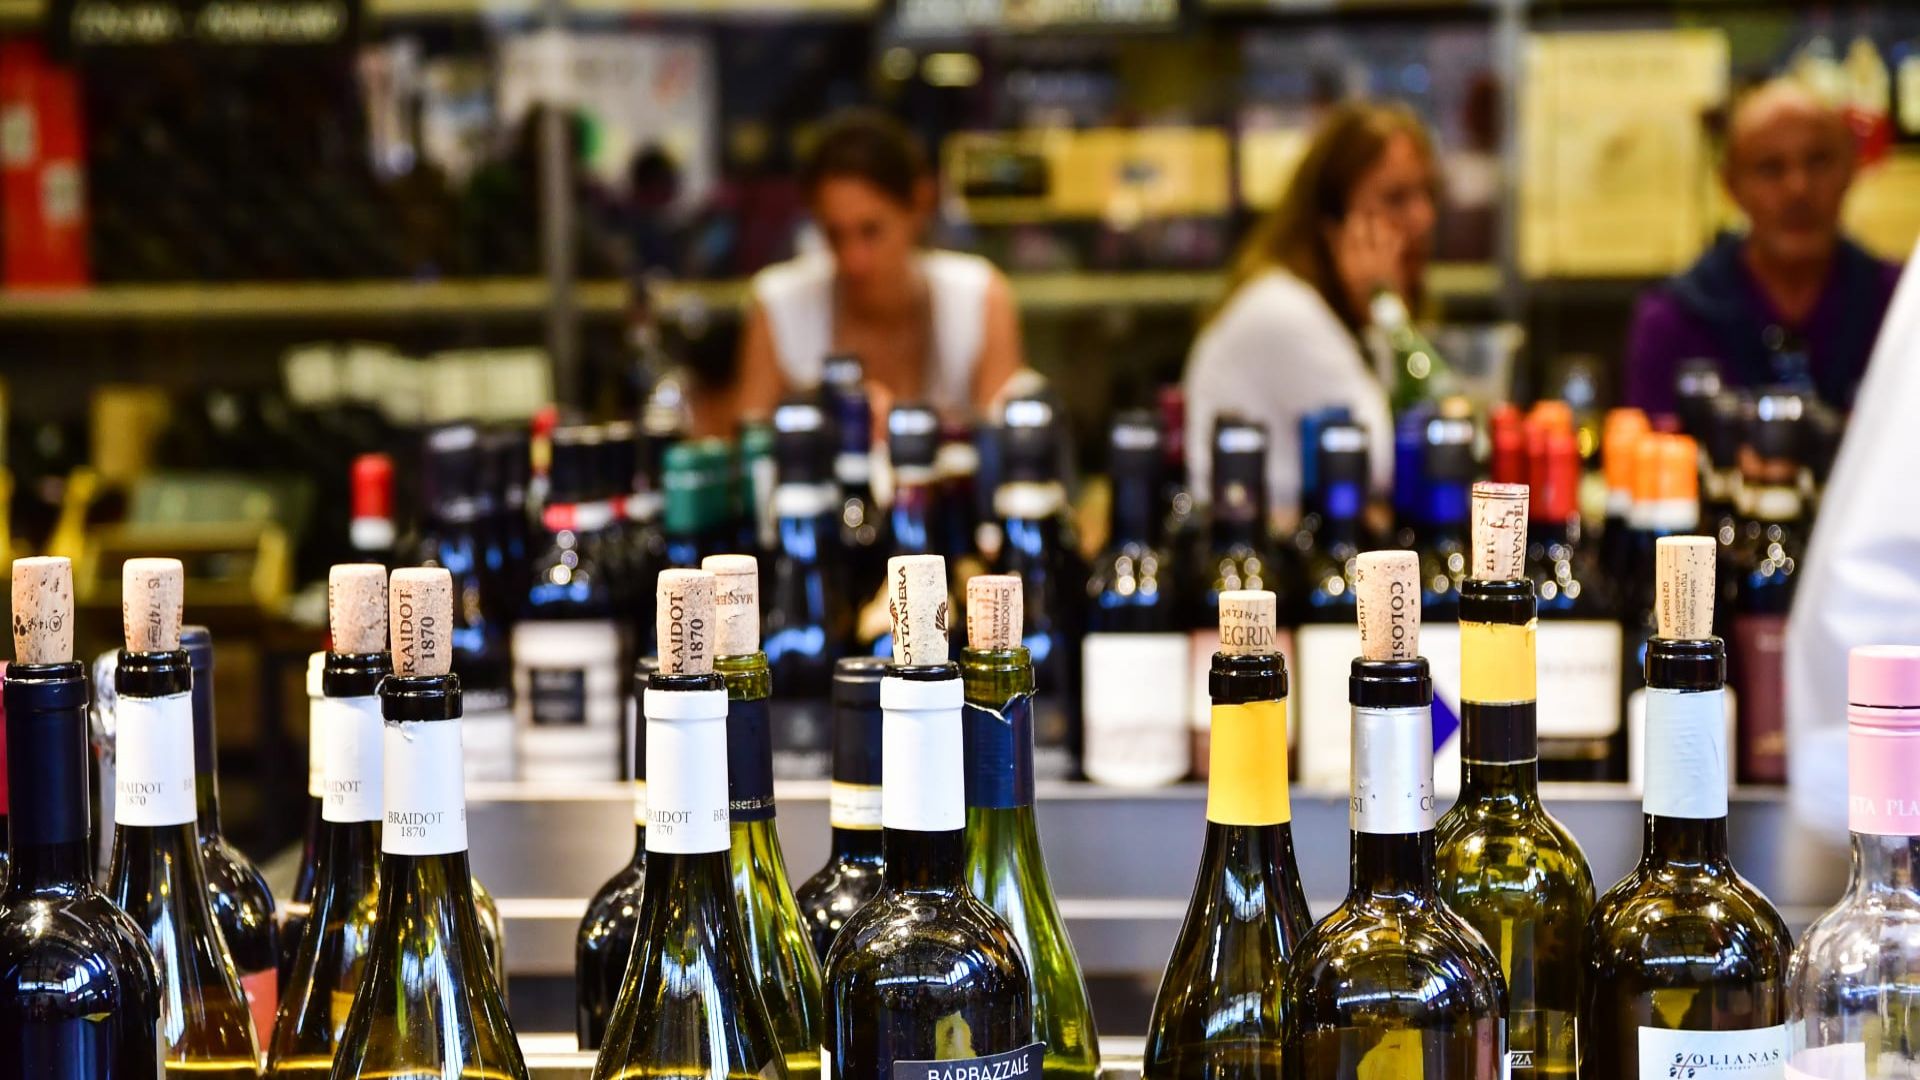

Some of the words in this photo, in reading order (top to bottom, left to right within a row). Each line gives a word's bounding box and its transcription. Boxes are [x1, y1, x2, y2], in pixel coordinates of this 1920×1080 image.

[898, 565, 912, 665] OTTANERA
[1391, 581, 1404, 659] COLOSI
[420, 616, 435, 660] 1870
[690, 618, 704, 660] 1870
[388, 811, 445, 825] BRAIDOT
[730, 797, 761, 810] sseria
[401, 827, 426, 838] 1870
[1693, 1049, 1779, 1066] OLIANAS
